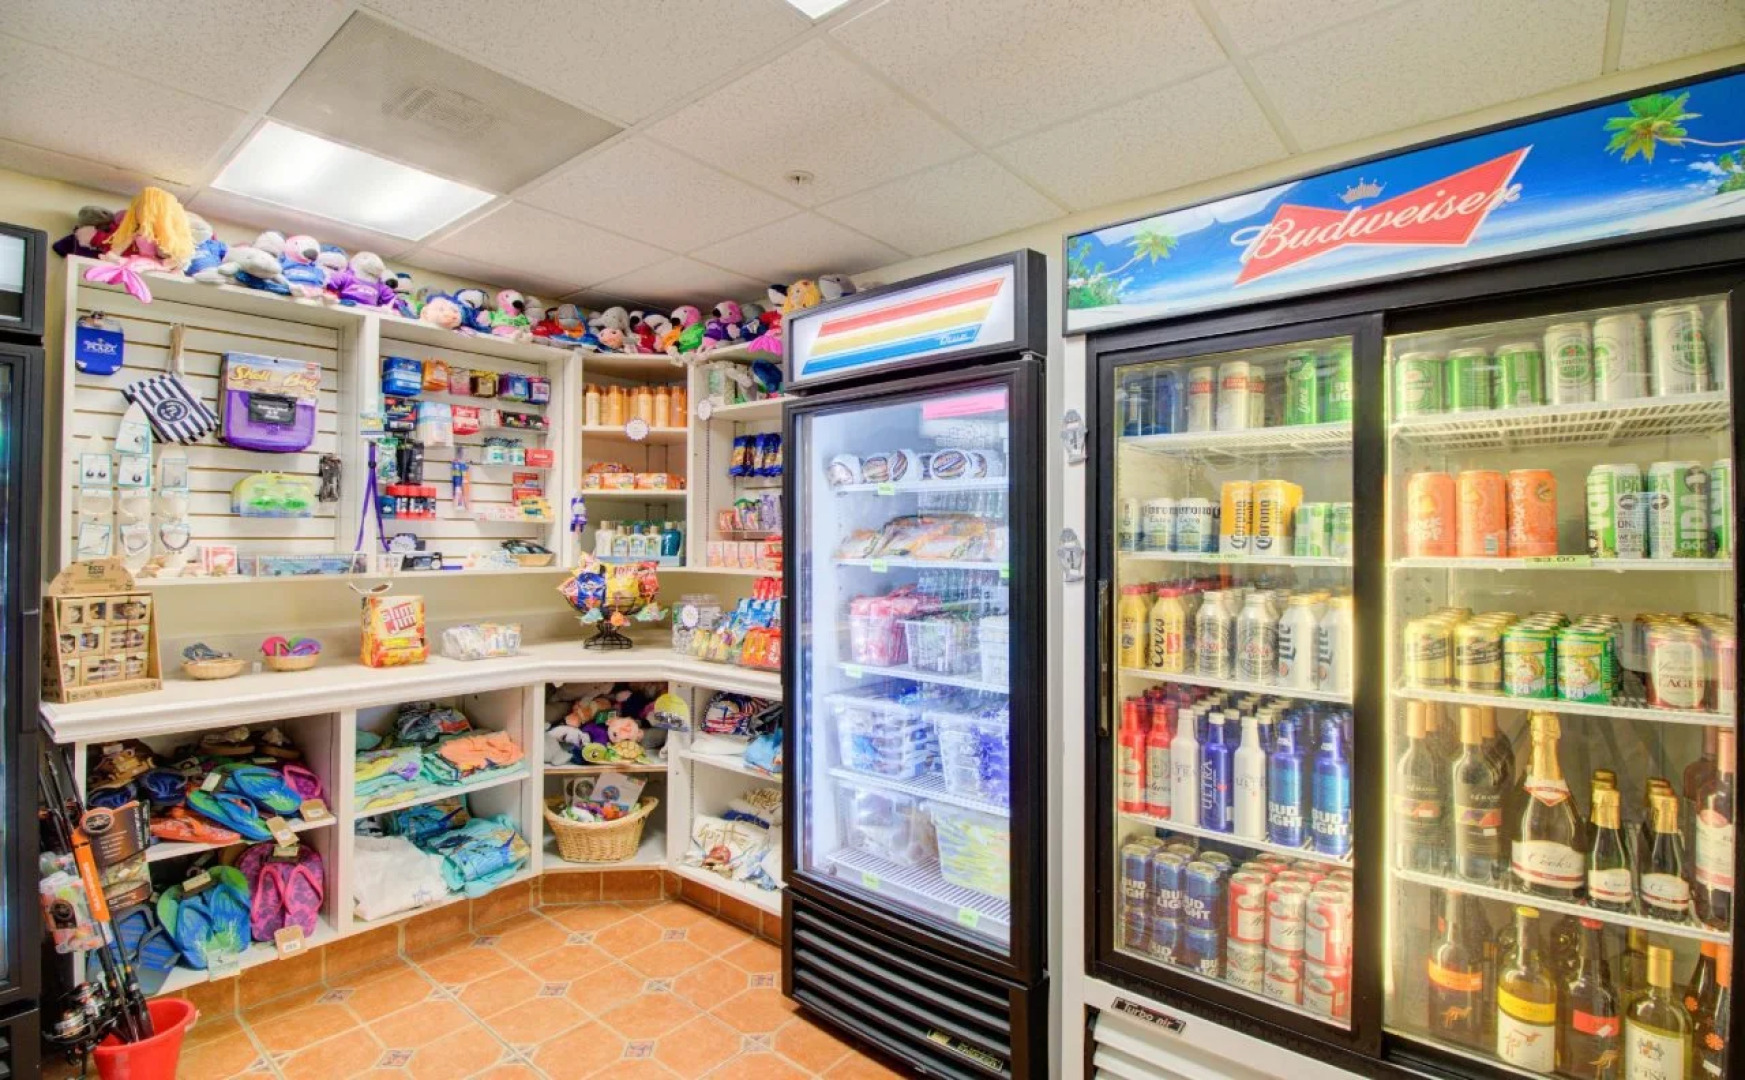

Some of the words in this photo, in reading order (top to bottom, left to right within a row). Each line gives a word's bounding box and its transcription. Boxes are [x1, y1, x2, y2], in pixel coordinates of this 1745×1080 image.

[1230, 182, 1523, 264] Budweiser
[1256, 499, 1272, 550] Corona
[1202, 759, 1213, 809] ULTRA
[1269, 812, 1302, 828] IGHT
[1312, 819, 1348, 836] IGHT
[1161, 889, 1181, 900] BU
[1125, 1003, 1153, 1021] Turbo
